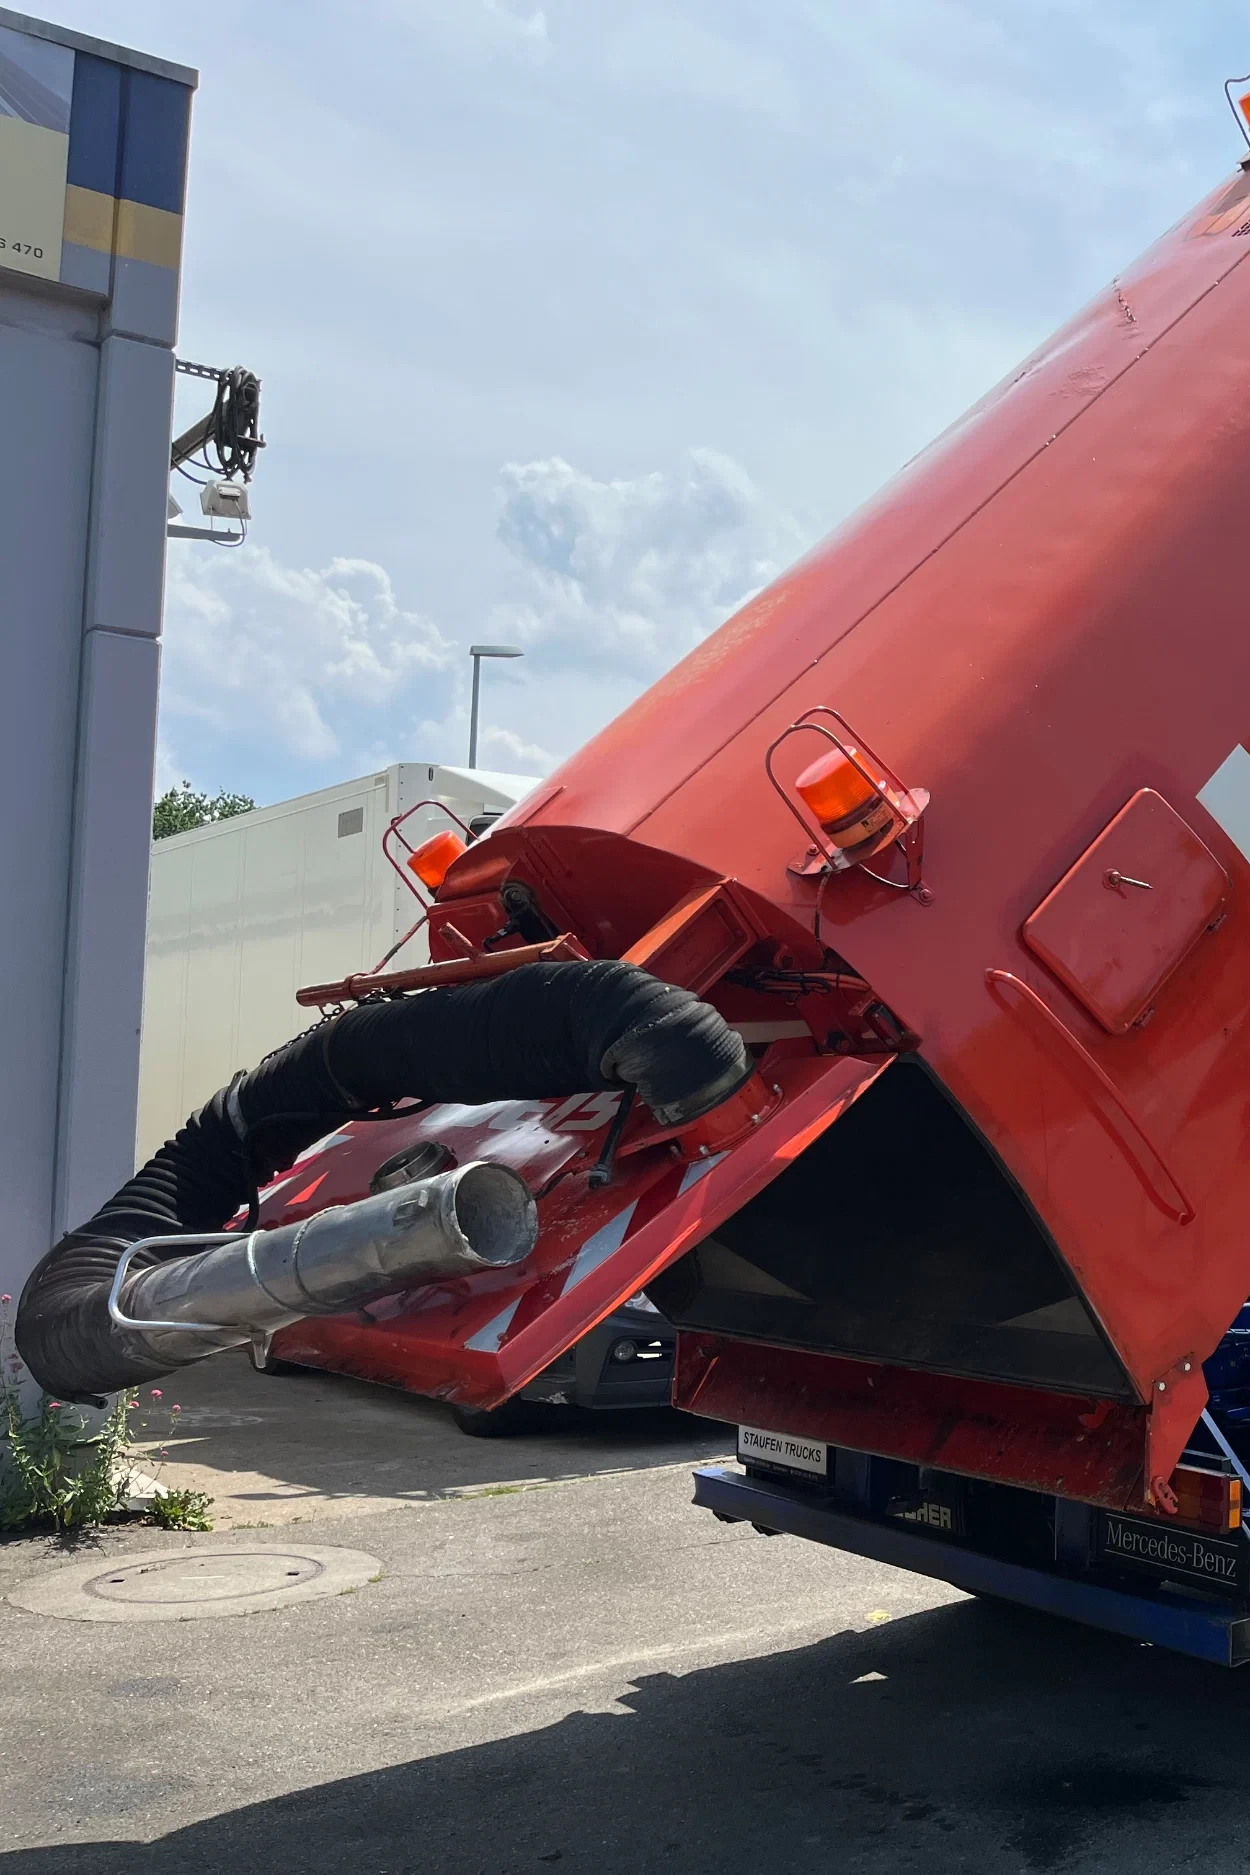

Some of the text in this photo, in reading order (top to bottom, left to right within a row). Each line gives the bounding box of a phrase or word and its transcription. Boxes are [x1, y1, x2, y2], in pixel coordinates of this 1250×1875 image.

[12, 242, 43, 259] 470
[743, 1431, 822, 1463] STAUFEN TRUCKS
[1106, 1520, 1237, 1578] Mercedes-Benz
